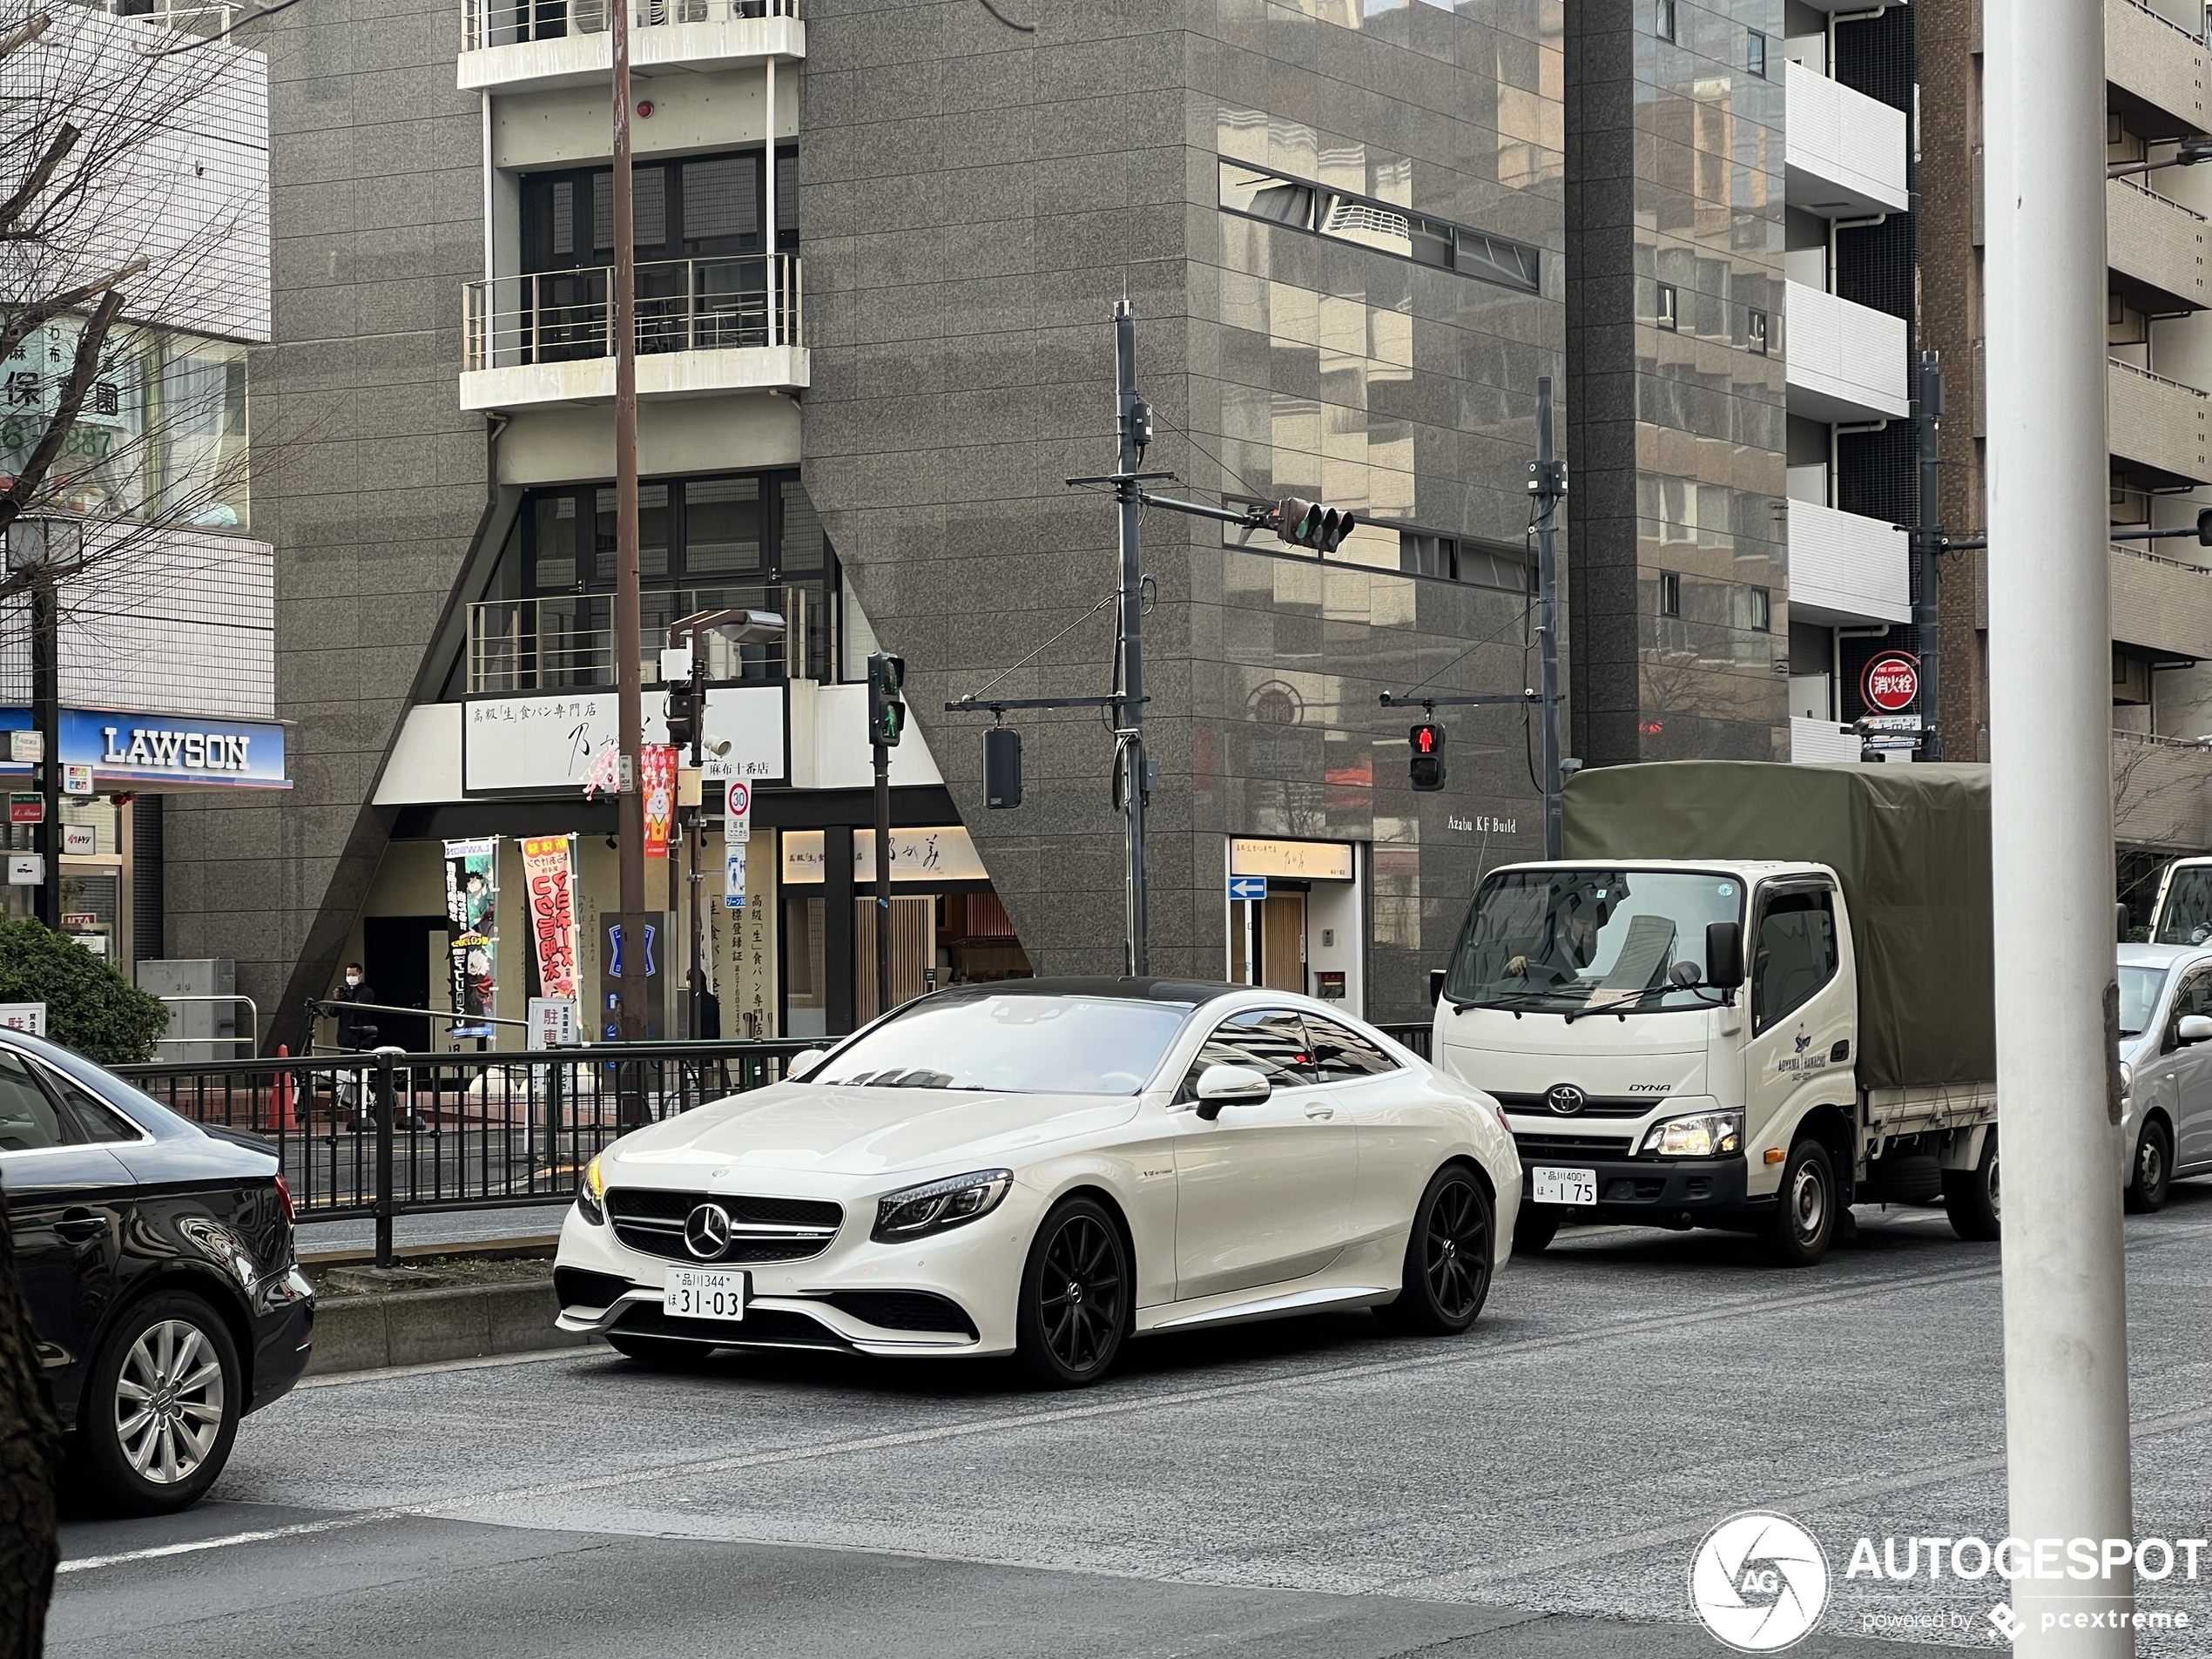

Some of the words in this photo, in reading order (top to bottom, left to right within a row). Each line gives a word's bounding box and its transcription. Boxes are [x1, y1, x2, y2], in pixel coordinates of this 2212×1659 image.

[1874, 674, 1913, 695] 消火栓
[475, 702, 597, 724] 高級「生」食パン専門店
[104, 727, 250, 771] LAWSON
[710, 761, 769, 776] 麻布十番店
[733, 792, 745, 806] 30
[1447, 814, 1473, 831] Azabu
[1476, 816, 1490, 832] KF
[1493, 817, 1516, 833] Build
[752, 894, 763, 1036] 高級「生」食パン専門店
[543, 1008, 558, 1043] 駐車
[1548, 1170, 1582, 1182] 品川400
[1537, 1186, 1546, 1196] ほ
[682, 1273, 725, 1288] 品川344
[668, 1294, 677, 1306] ほ
[680, 1289, 738, 1316] 31-03
